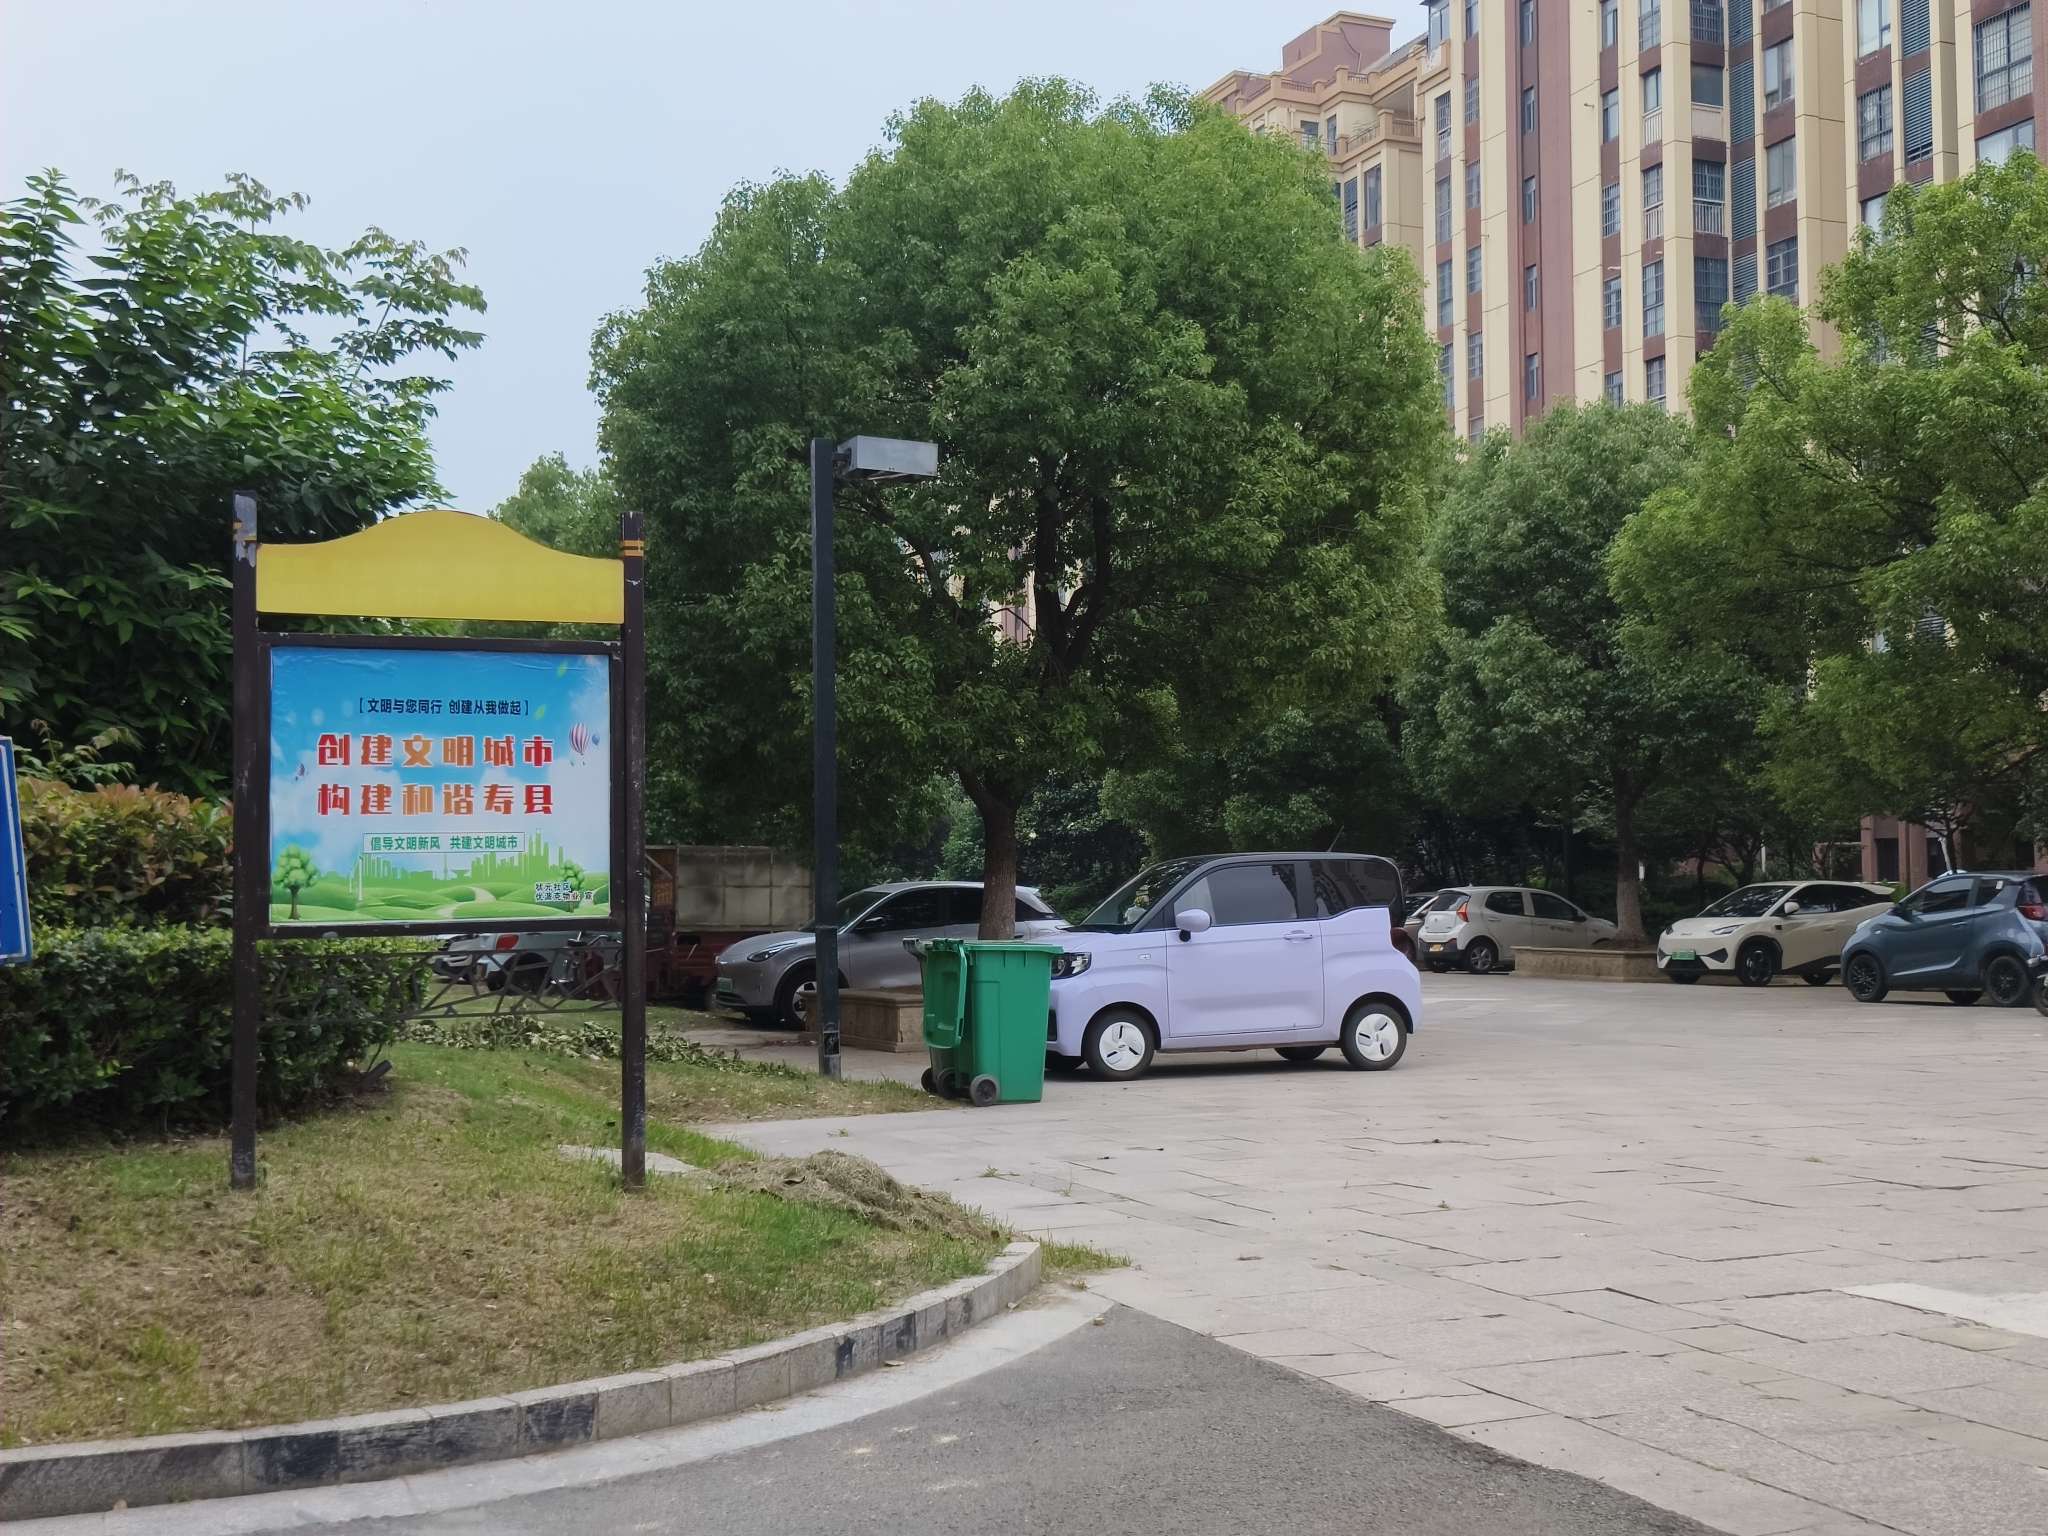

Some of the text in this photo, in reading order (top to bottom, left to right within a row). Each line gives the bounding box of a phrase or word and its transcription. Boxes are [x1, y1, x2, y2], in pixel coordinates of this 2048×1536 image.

[317, 733, 554, 768] 创建文明城市
[317, 783, 553, 816] 构建和谐寿县
[370, 835, 518, 851] 倡导文明新风 共建文明城市
